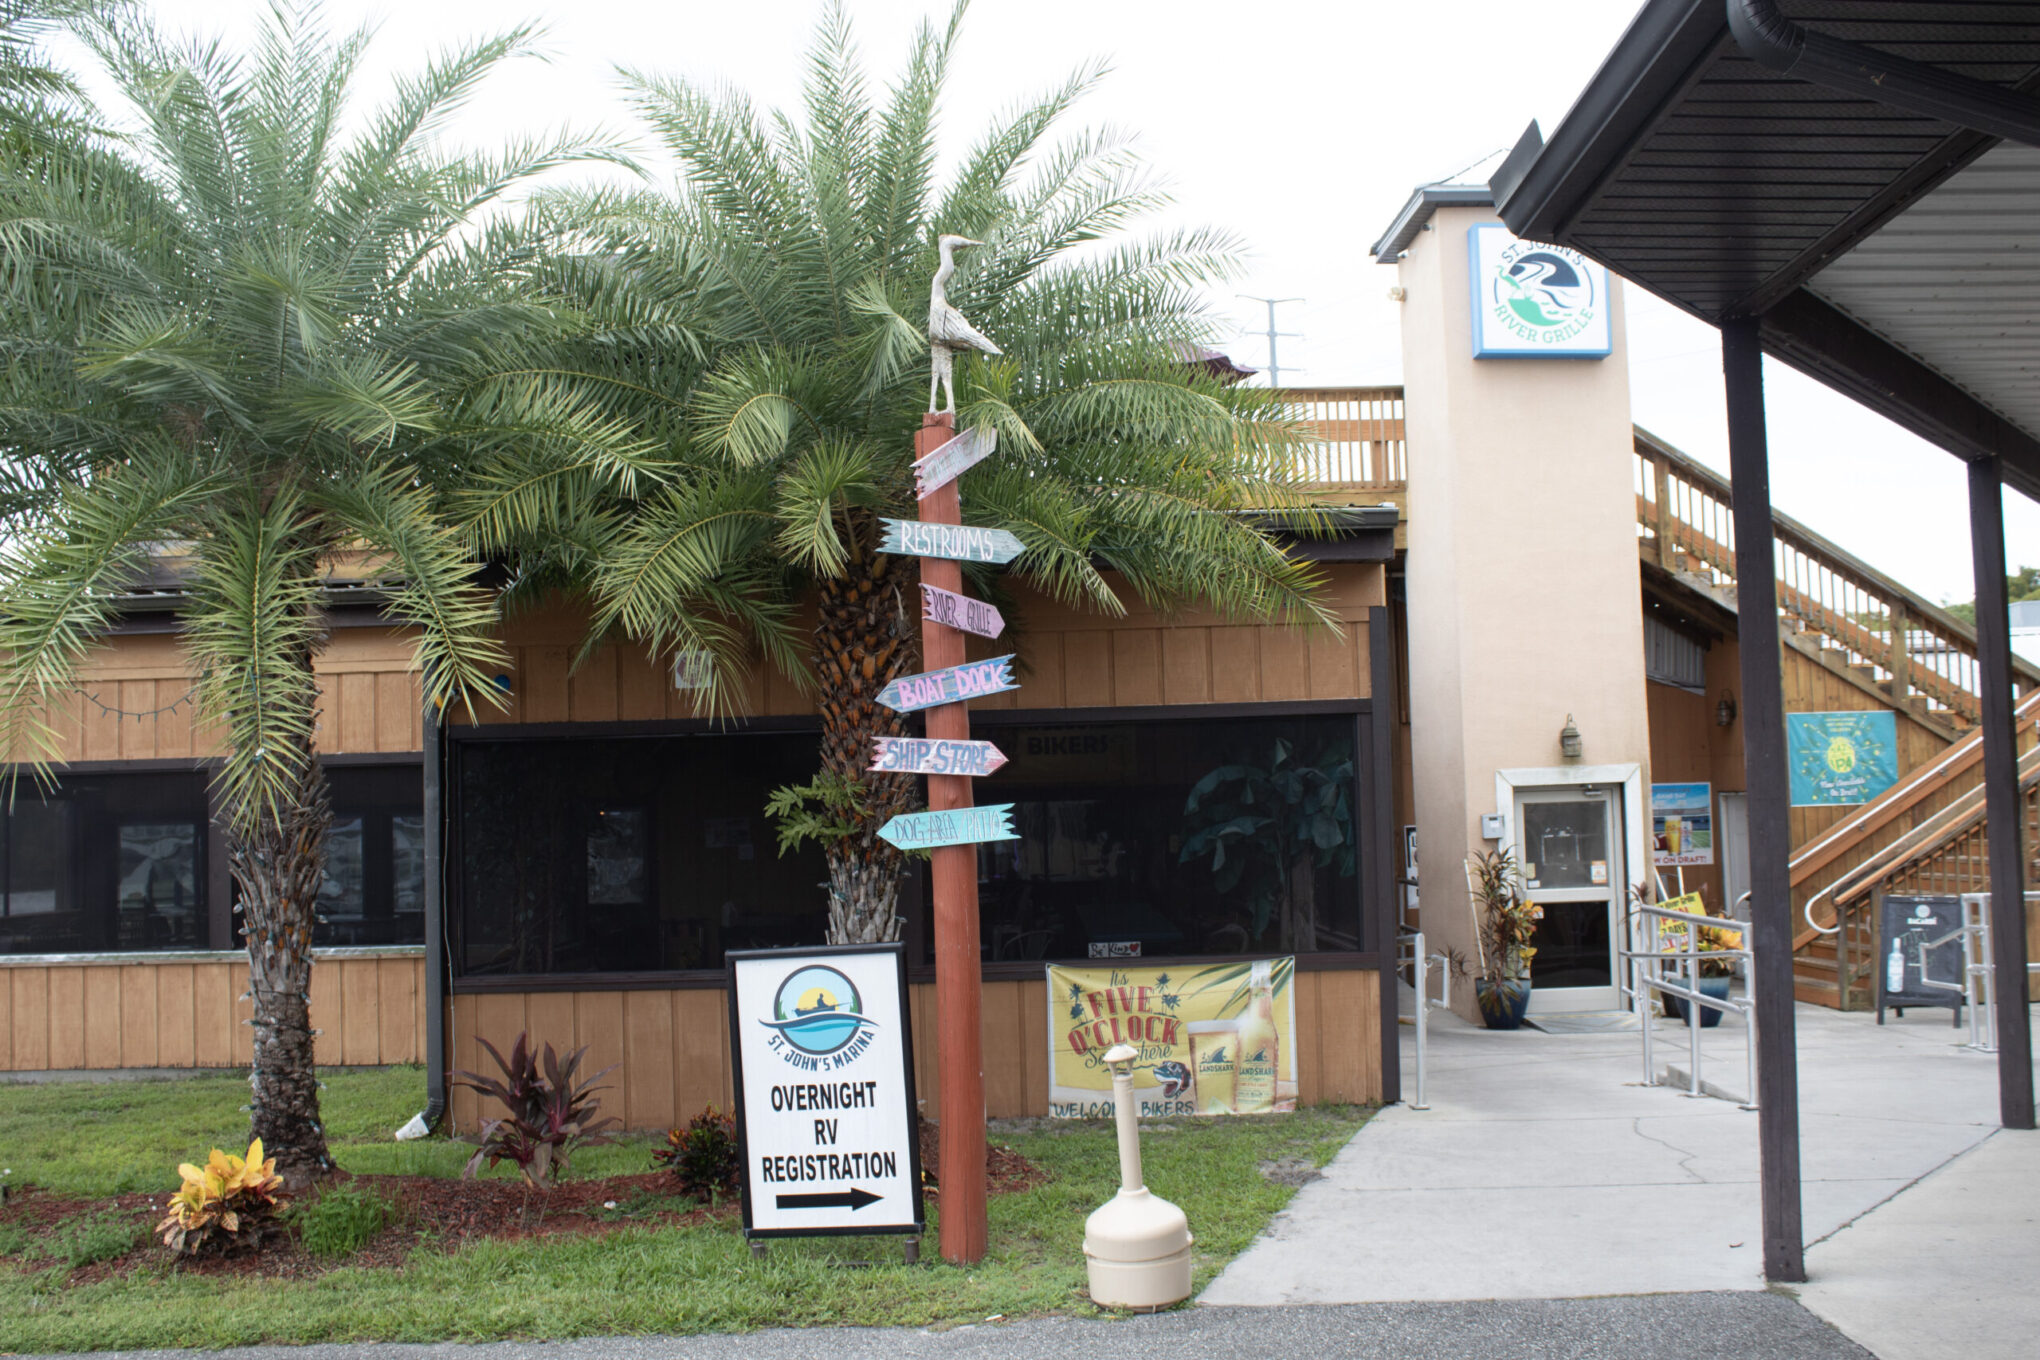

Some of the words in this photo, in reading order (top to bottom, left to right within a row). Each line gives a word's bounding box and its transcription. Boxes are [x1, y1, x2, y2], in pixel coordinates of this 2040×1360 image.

[1502, 243, 1524, 263] ST.
[1494, 304, 1538, 343] RIVER
[1542, 307, 1594, 344] GRILLE
[901, 520, 994, 561] RESTROOMS
[931, 588, 962, 628] RIVER
[967, 600, 992, 636] GRILLE
[897, 673, 946, 709] BOAT
[953, 663, 1007, 697] DOCK
[933, 741, 991, 775] STORE
[1027, 735, 1108, 755] BIKERS
[894, 816, 925, 845] DOG
[1086, 986, 1154, 1020] FIVE
[768, 1034, 785, 1056] ST.
[784, 1048, 831, 1072] JOHN'S
[832, 1029, 875, 1069] MARINA
[1067, 1015, 1182, 1056] O'CLOCK
[1199, 1064, 1235, 1073] LANDSHARK
[770, 1081, 877, 1113] OVERNIGHT
[1053, 1101, 1116, 1118] WELCO
[1141, 1101, 1195, 1117] BIKERS
[813, 1118, 839, 1146] RV
[762, 1151, 897, 1183] REGISTRATION
